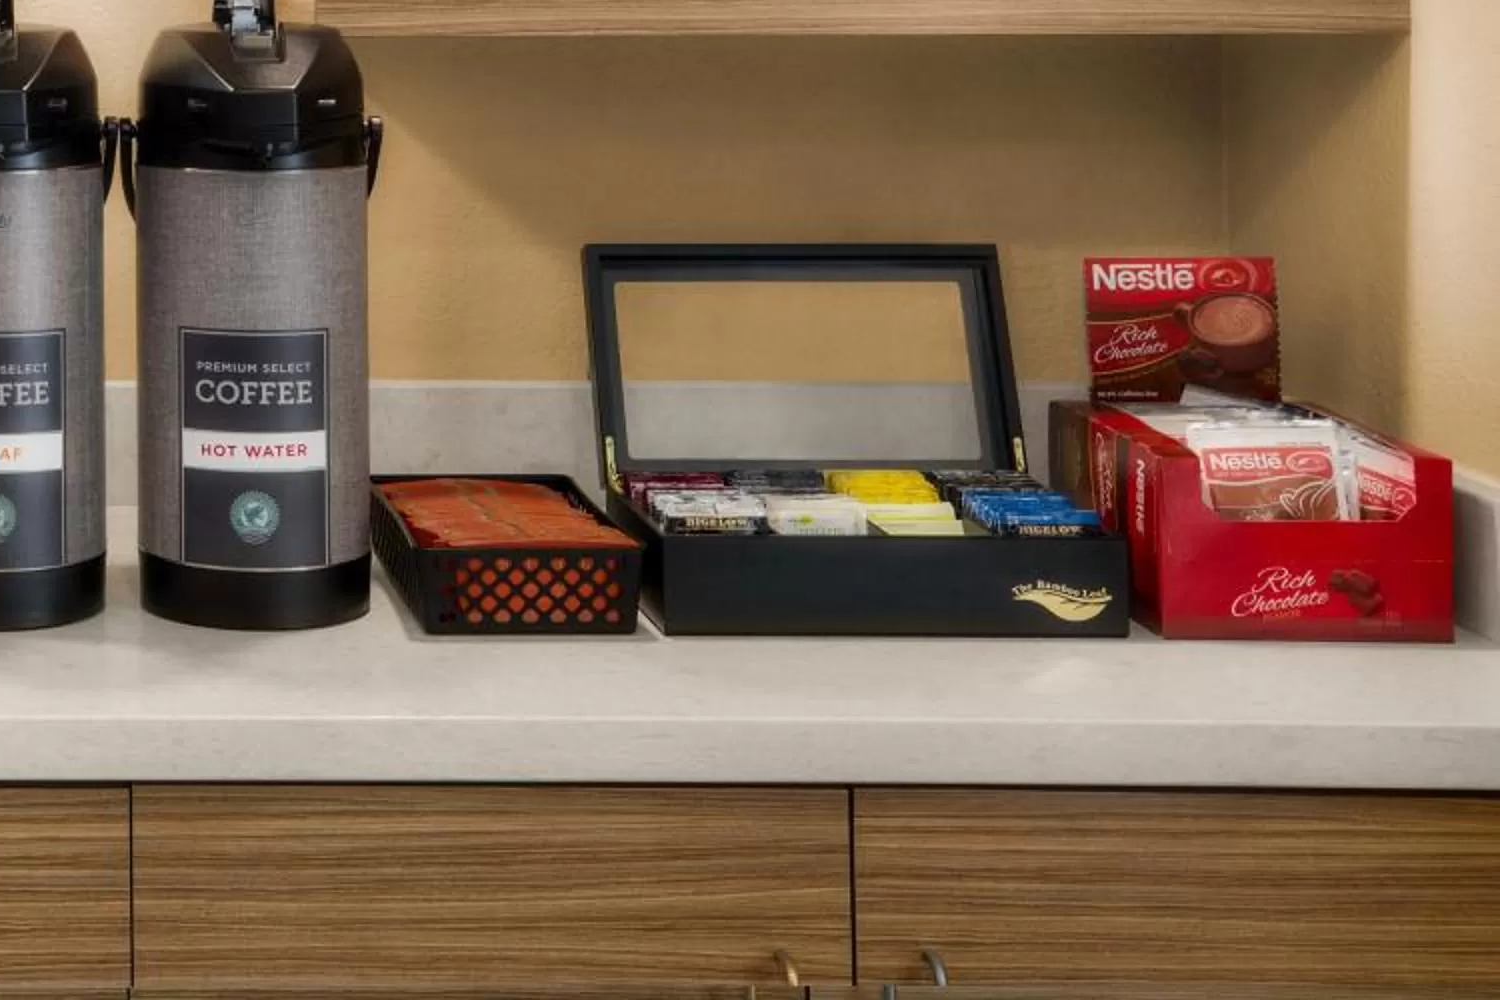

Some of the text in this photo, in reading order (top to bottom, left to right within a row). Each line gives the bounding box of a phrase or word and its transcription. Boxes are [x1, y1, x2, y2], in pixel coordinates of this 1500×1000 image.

[1110, 324, 1159, 346] Rich
[1094, 340, 1169, 364] Chocolate
[0, 362, 49, 375] SELECT
[195, 360, 312, 373] PREMIUM SELECT
[195, 379, 312, 405] COFFEE
[201, 443, 308, 457] HOT WATER
[1012, 583, 1033, 597] The
[1251, 566, 1317, 593] Rich
[1231, 590, 1330, 617] Chocolate
